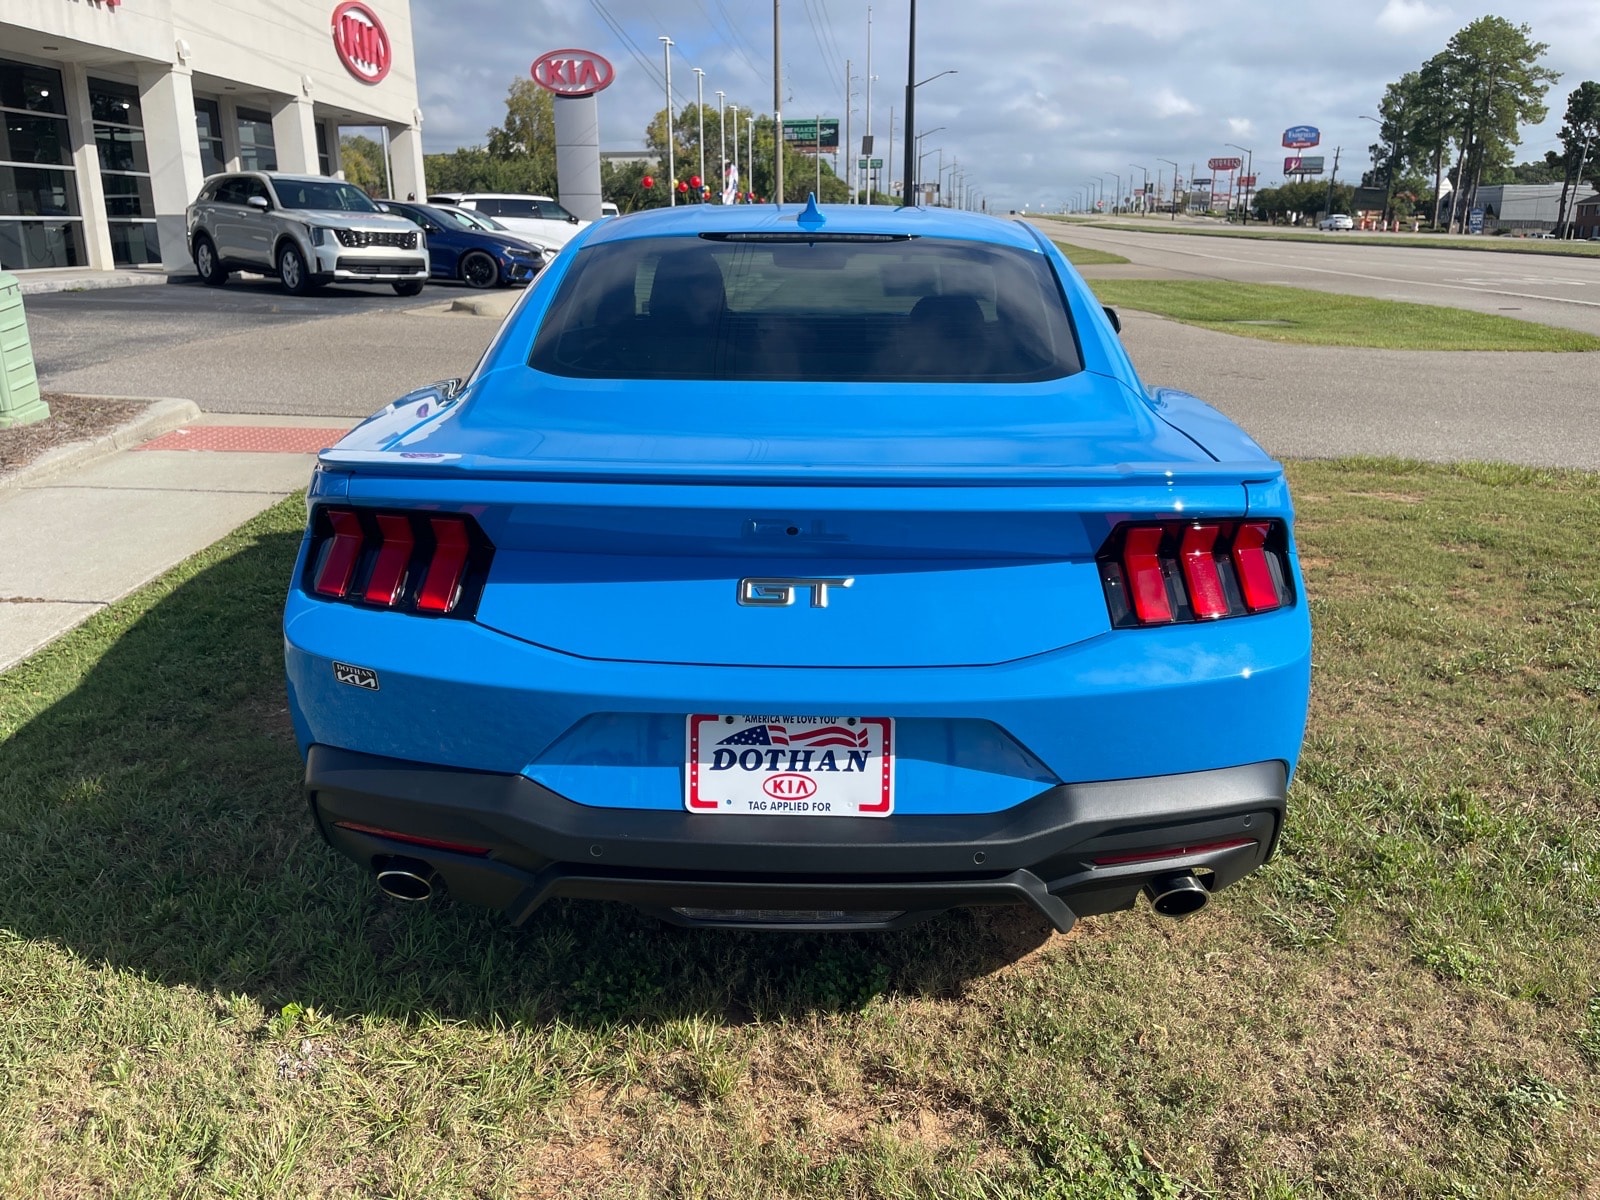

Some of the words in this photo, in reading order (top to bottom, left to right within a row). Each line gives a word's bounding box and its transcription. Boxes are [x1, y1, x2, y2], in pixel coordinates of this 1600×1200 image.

[340, 14, 385, 73] KIA
[544, 59, 601, 85] KIA
[737, 577, 855, 608] GT
[336, 664, 373, 677] DOTHAN
[783, 715, 795, 724] WE
[797, 716, 817, 724] LOVE
[709, 748, 872, 772] DOTHAN
[773, 780, 809, 794] KIA
[748, 801, 767, 811] TAG
[770, 801, 809, 811] APPLIED
[812, 802, 831, 812] FOR
